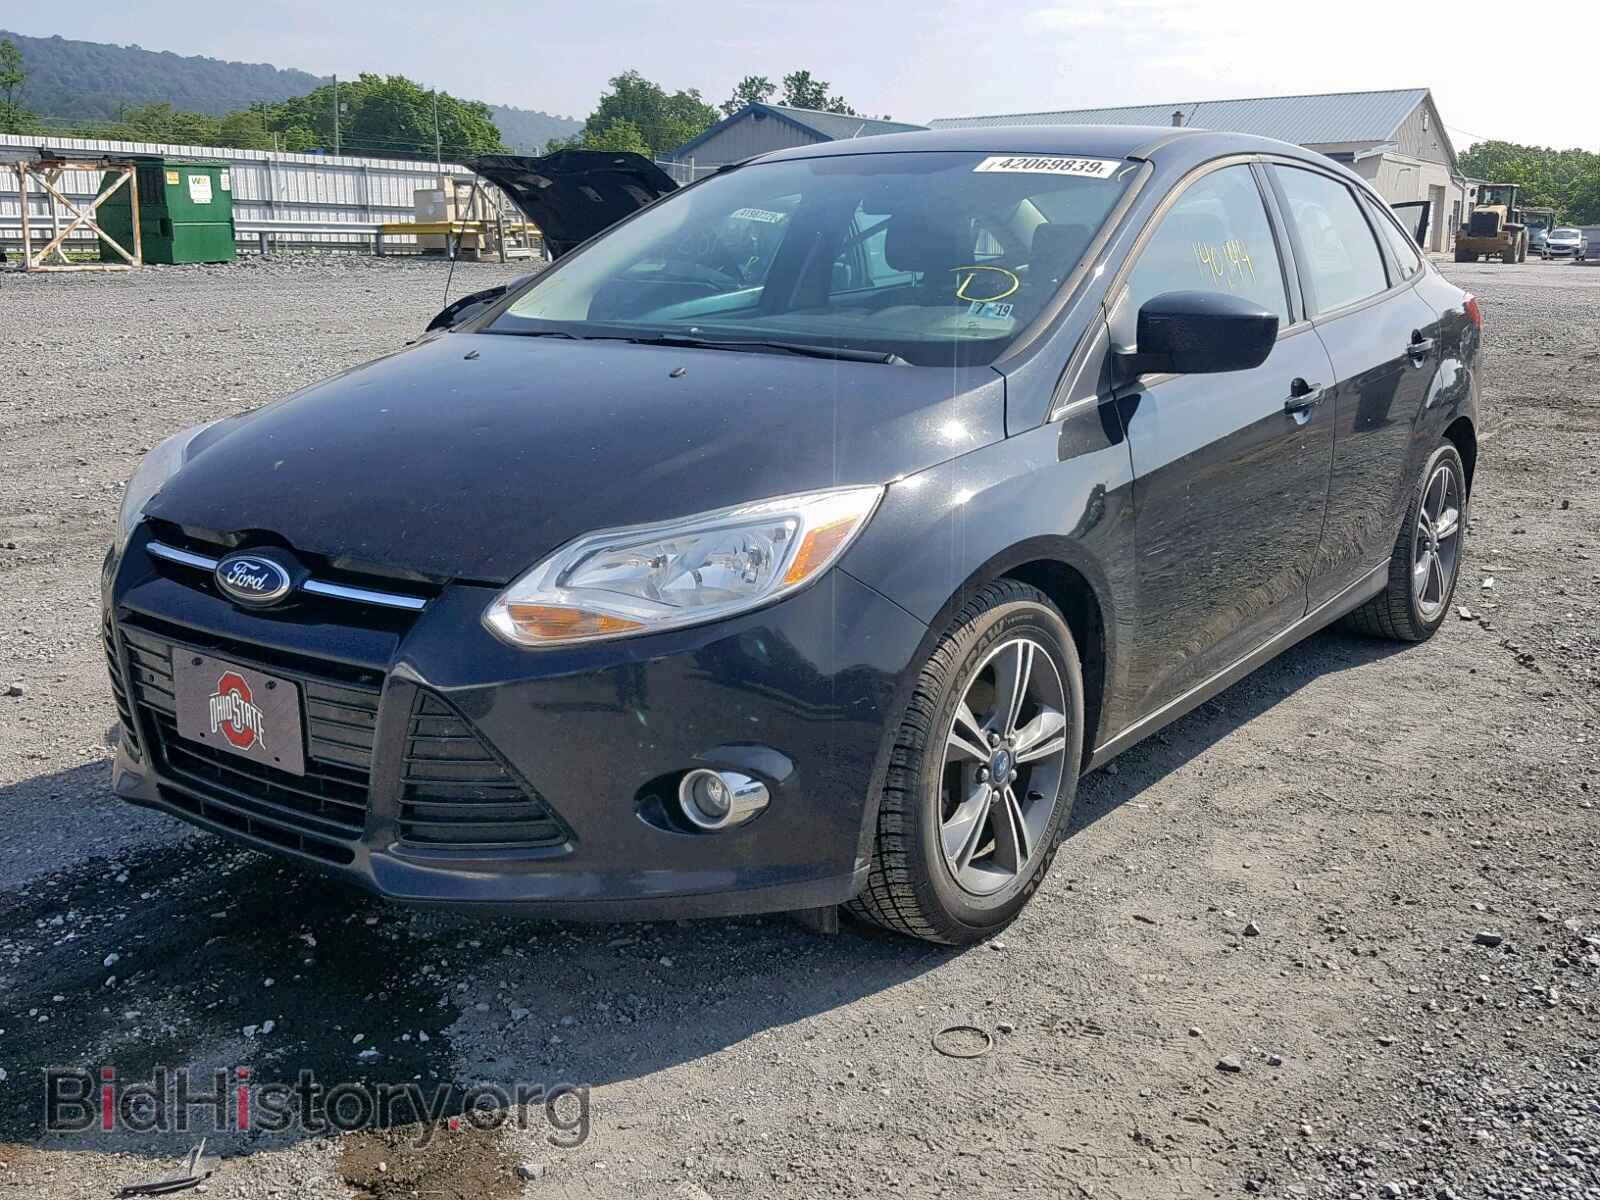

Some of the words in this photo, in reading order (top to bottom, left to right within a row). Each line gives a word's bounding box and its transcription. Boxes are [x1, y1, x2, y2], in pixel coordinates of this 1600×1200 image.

[999, 158, 1102, 173] 42069839
[949, 266, 1019, 302] D
[227, 561, 269, 590] Ford
